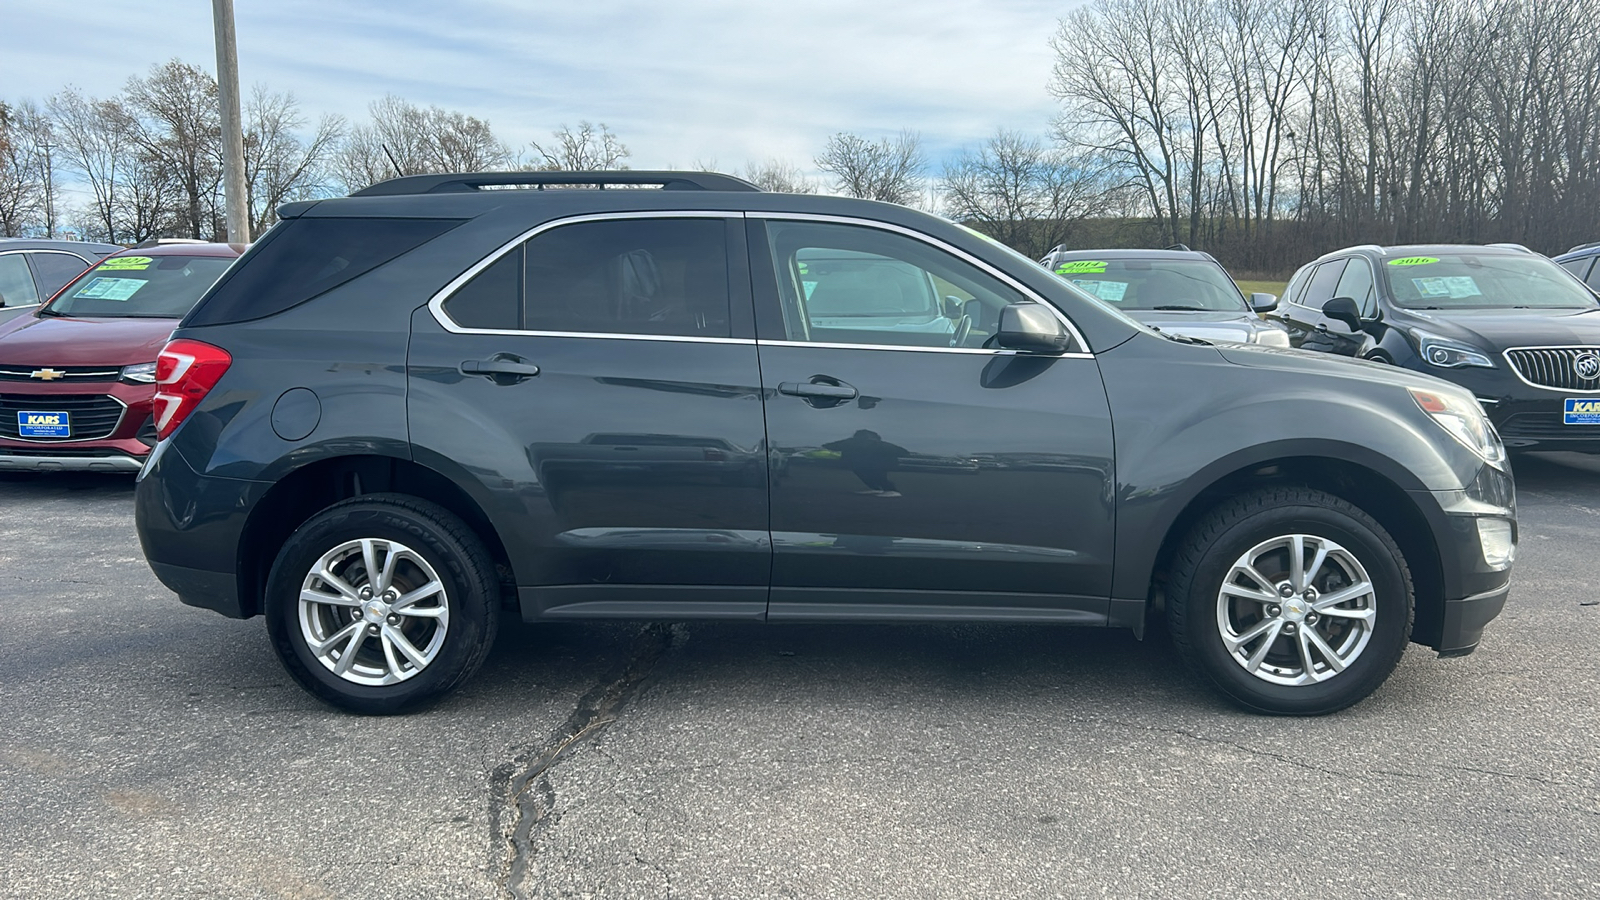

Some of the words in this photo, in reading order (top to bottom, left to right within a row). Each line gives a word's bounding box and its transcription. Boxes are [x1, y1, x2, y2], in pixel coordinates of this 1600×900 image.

[1398, 257, 1430, 265] 2016
[1573, 402, 1600, 411] KAR
[27, 415, 60, 424] KARS
